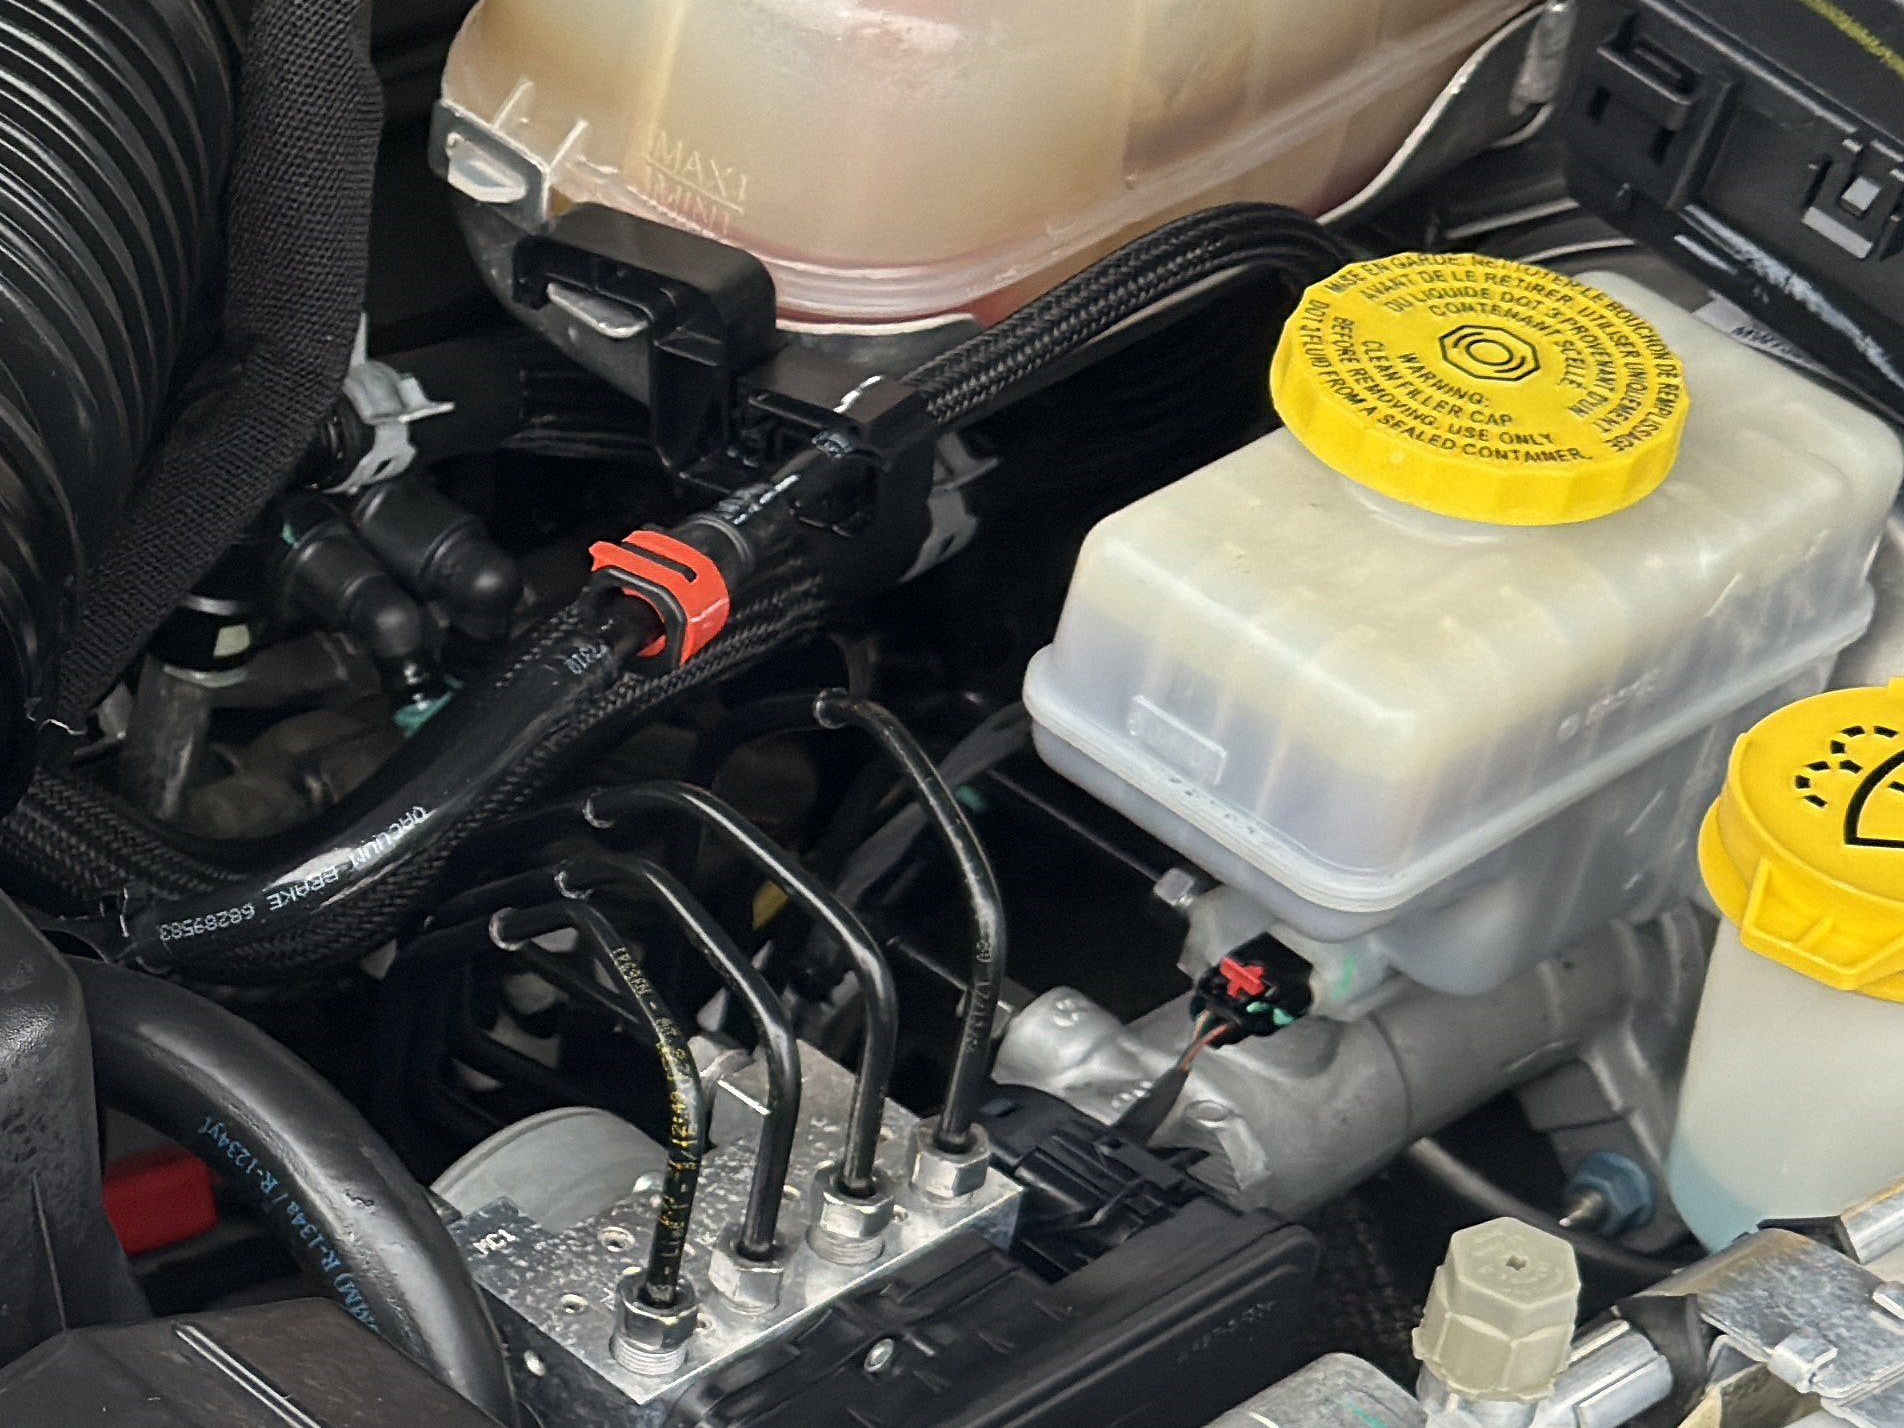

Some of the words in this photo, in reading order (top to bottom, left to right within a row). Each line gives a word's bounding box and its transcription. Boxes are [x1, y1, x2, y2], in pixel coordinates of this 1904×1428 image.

[1469, 410, 1513, 428] CAP
[1447, 423, 1490, 442] USE
[1499, 431, 1554, 446] ONLY
